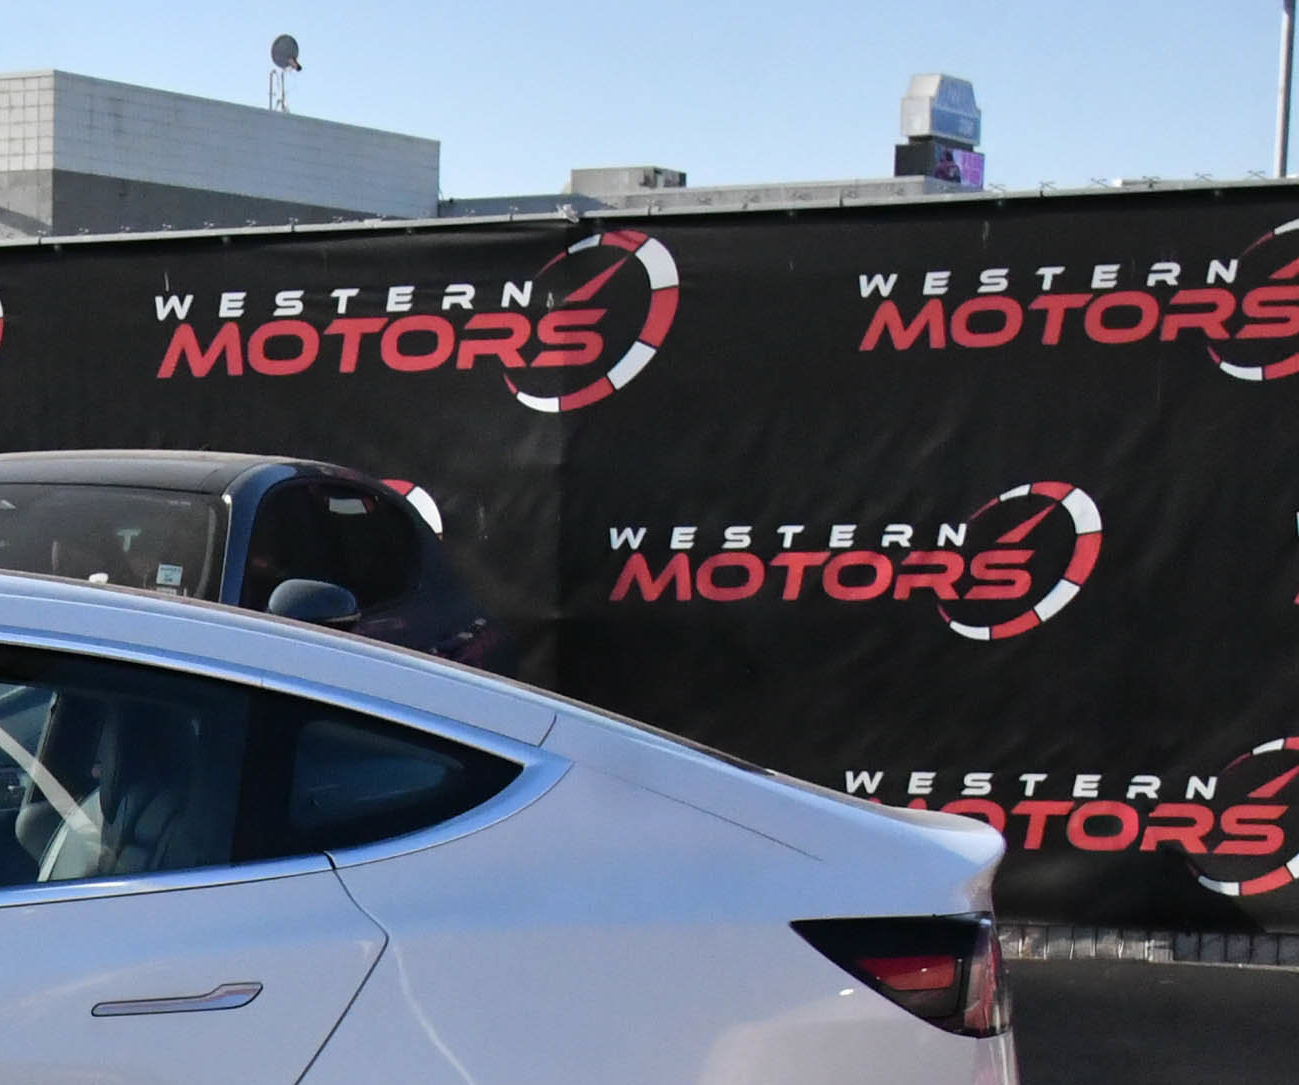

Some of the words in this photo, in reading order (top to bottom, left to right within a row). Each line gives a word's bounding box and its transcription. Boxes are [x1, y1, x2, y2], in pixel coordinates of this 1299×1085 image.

[155, 281, 532, 321] WESTERN
[859, 259, 1238, 298] WESTERN
[859, 286, 1299, 351] MOTORS
[156, 308, 608, 379] MOTORS
[610, 523, 968, 550] WESTERN
[609, 549, 1035, 601] MOTORS
[845, 770, 1218, 800] WESTERN
[869, 797, 1290, 855] TORS
